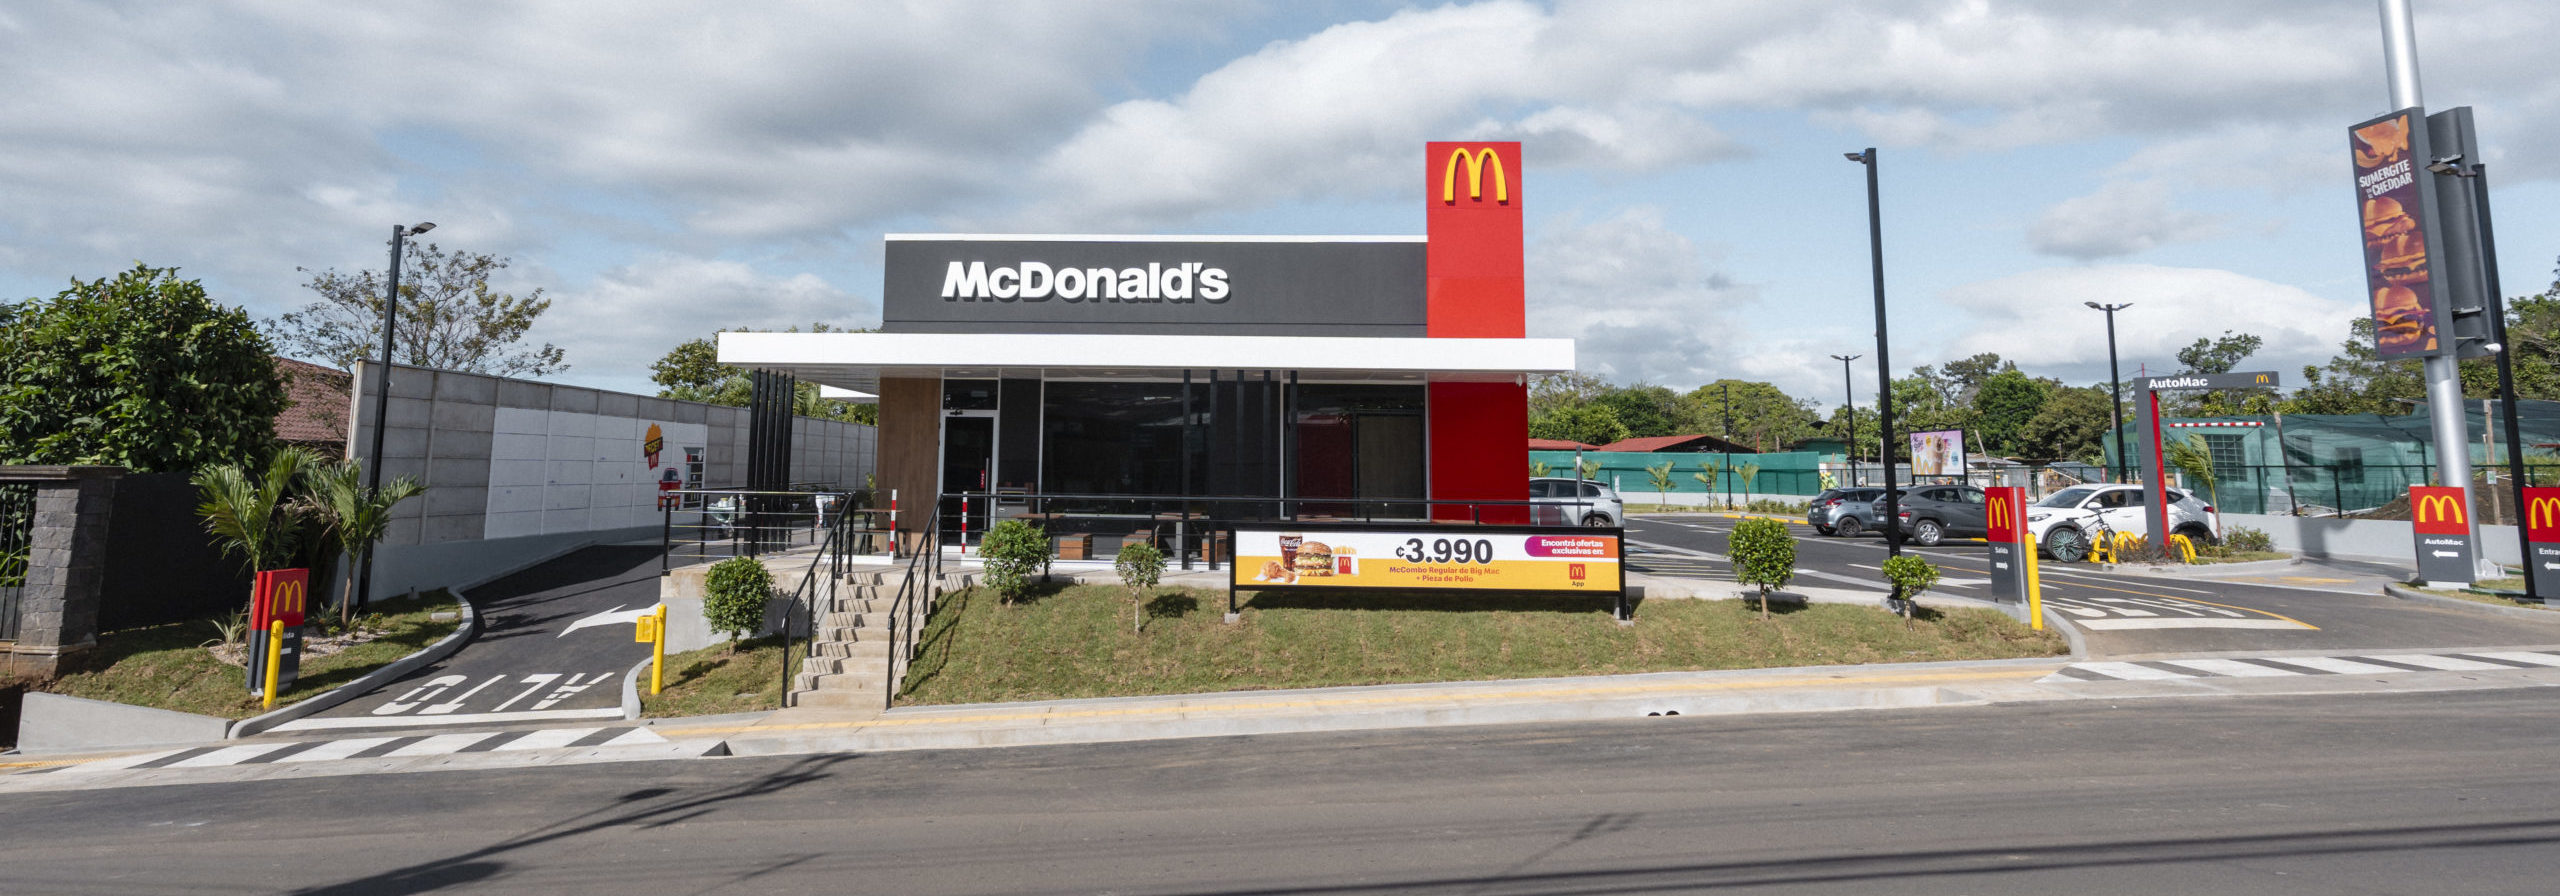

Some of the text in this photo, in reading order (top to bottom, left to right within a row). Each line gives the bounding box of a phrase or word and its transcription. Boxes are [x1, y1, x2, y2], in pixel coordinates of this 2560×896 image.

[2359, 159, 2411, 188] SUMERGITE
[2371, 172, 2413, 196] CHEDDAR
[941, 261, 1230, 300] McDonald's
[2148, 377, 2209, 389] AutoMac
[1541, 539, 1604, 547] Encontrá ofertas
[2424, 538, 2464, 546] AutoMac
[1551, 547, 1591, 555] exclusivas
[1389, 566, 1427, 574] McCombo
[1429, 567, 1458, 576] Regular
[1470, 567, 1482, 576] Big
[371, 672, 615, 715] ALTO
